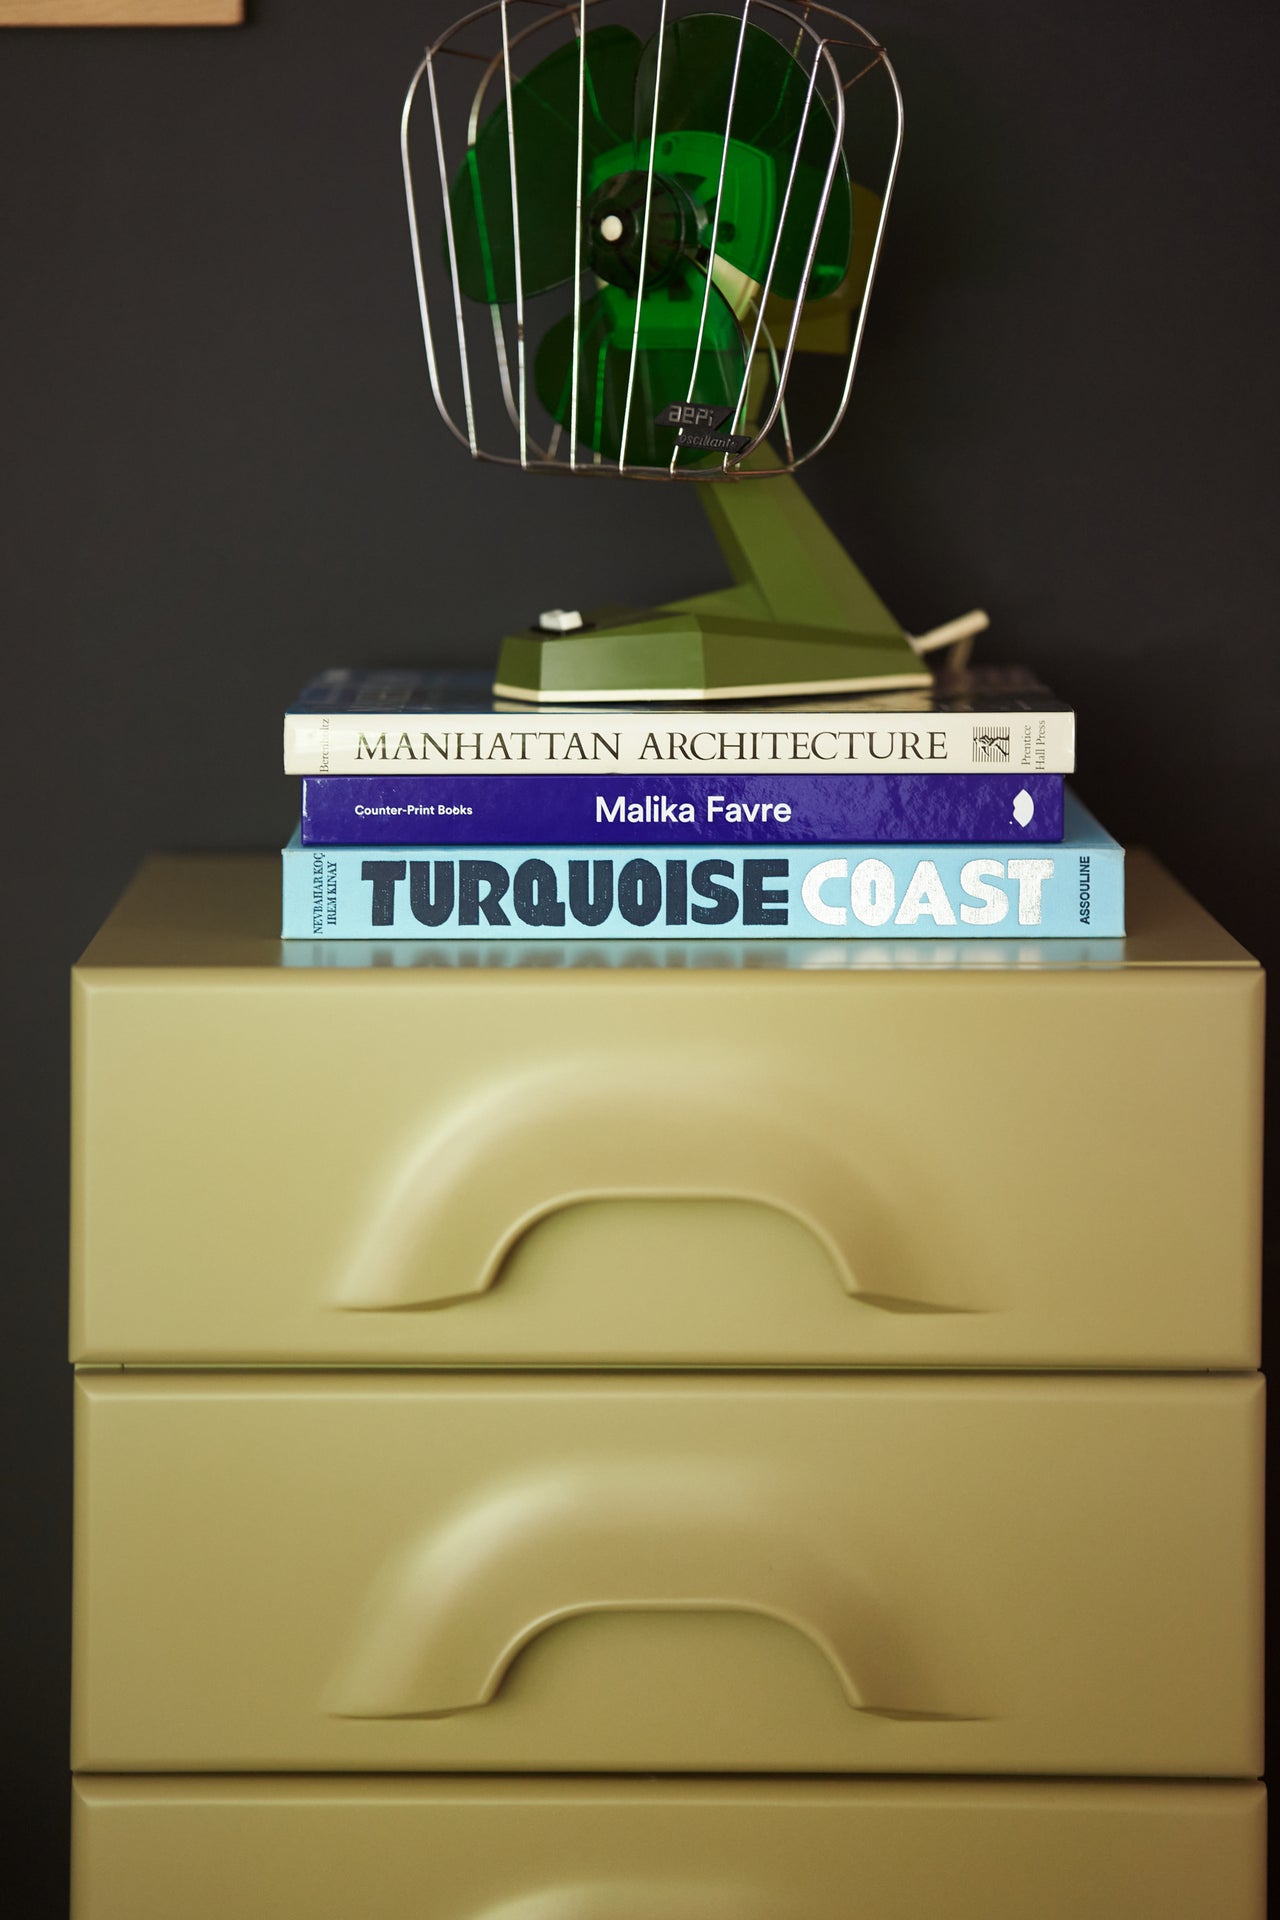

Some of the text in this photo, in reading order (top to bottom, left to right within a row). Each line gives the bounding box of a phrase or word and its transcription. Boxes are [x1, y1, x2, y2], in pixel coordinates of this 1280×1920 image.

[354, 731, 948, 761] MANHATTAN ARCHITECTURE
[1020, 724, 1031, 766] Prentice
[1035, 720, 1045, 770] Hall Press
[354, 804, 473, 817] Counter-Print Books
[595, 795, 792, 824] Malika Favre
[313, 852, 325, 935] NEVBAHAR KOÇ
[327, 861, 337, 926] IREM KINAY
[361, 858, 1055, 927] TURQUOISE COAST
[1079, 855, 1091, 925] ASSOULINE
